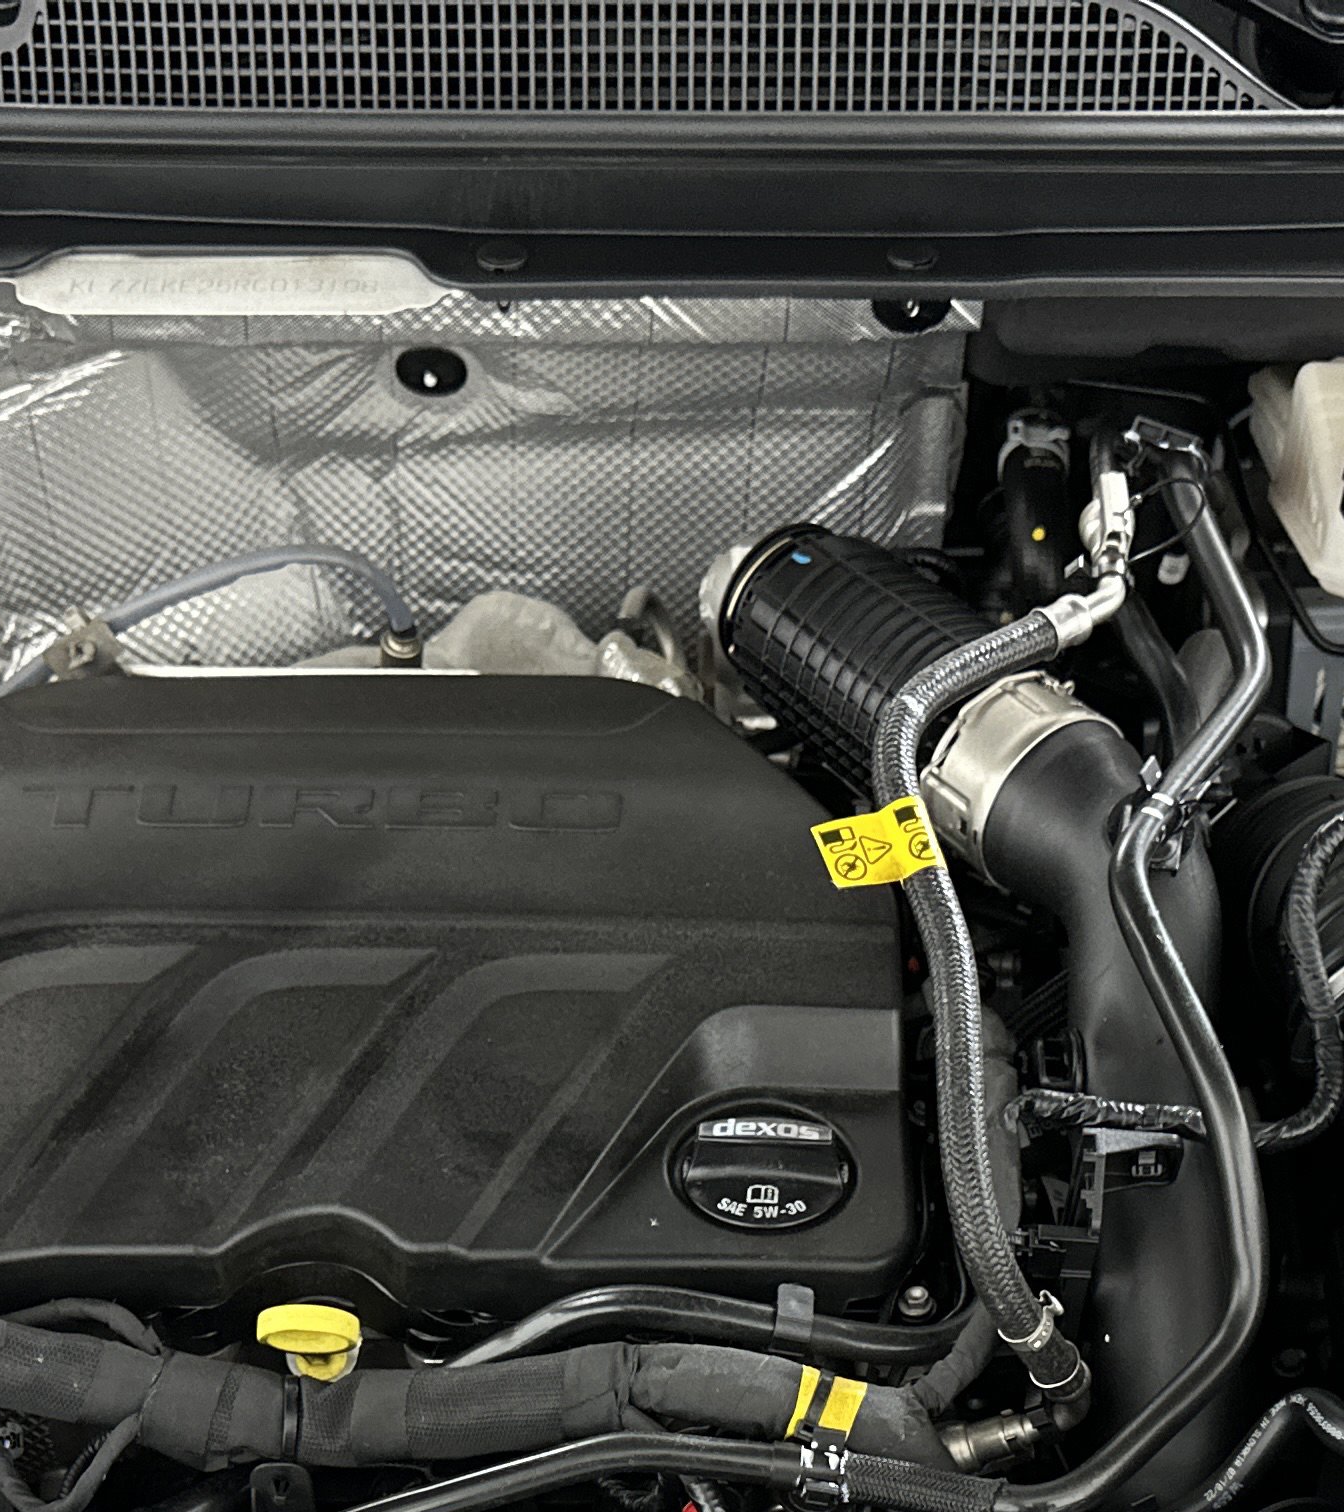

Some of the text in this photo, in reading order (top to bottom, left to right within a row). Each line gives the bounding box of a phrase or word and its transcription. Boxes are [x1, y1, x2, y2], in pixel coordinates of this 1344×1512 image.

[22, 784, 625, 833] TURBO
[712, 1118, 820, 1141] dexos
[716, 1197, 807, 1219] SAE 5W-30
